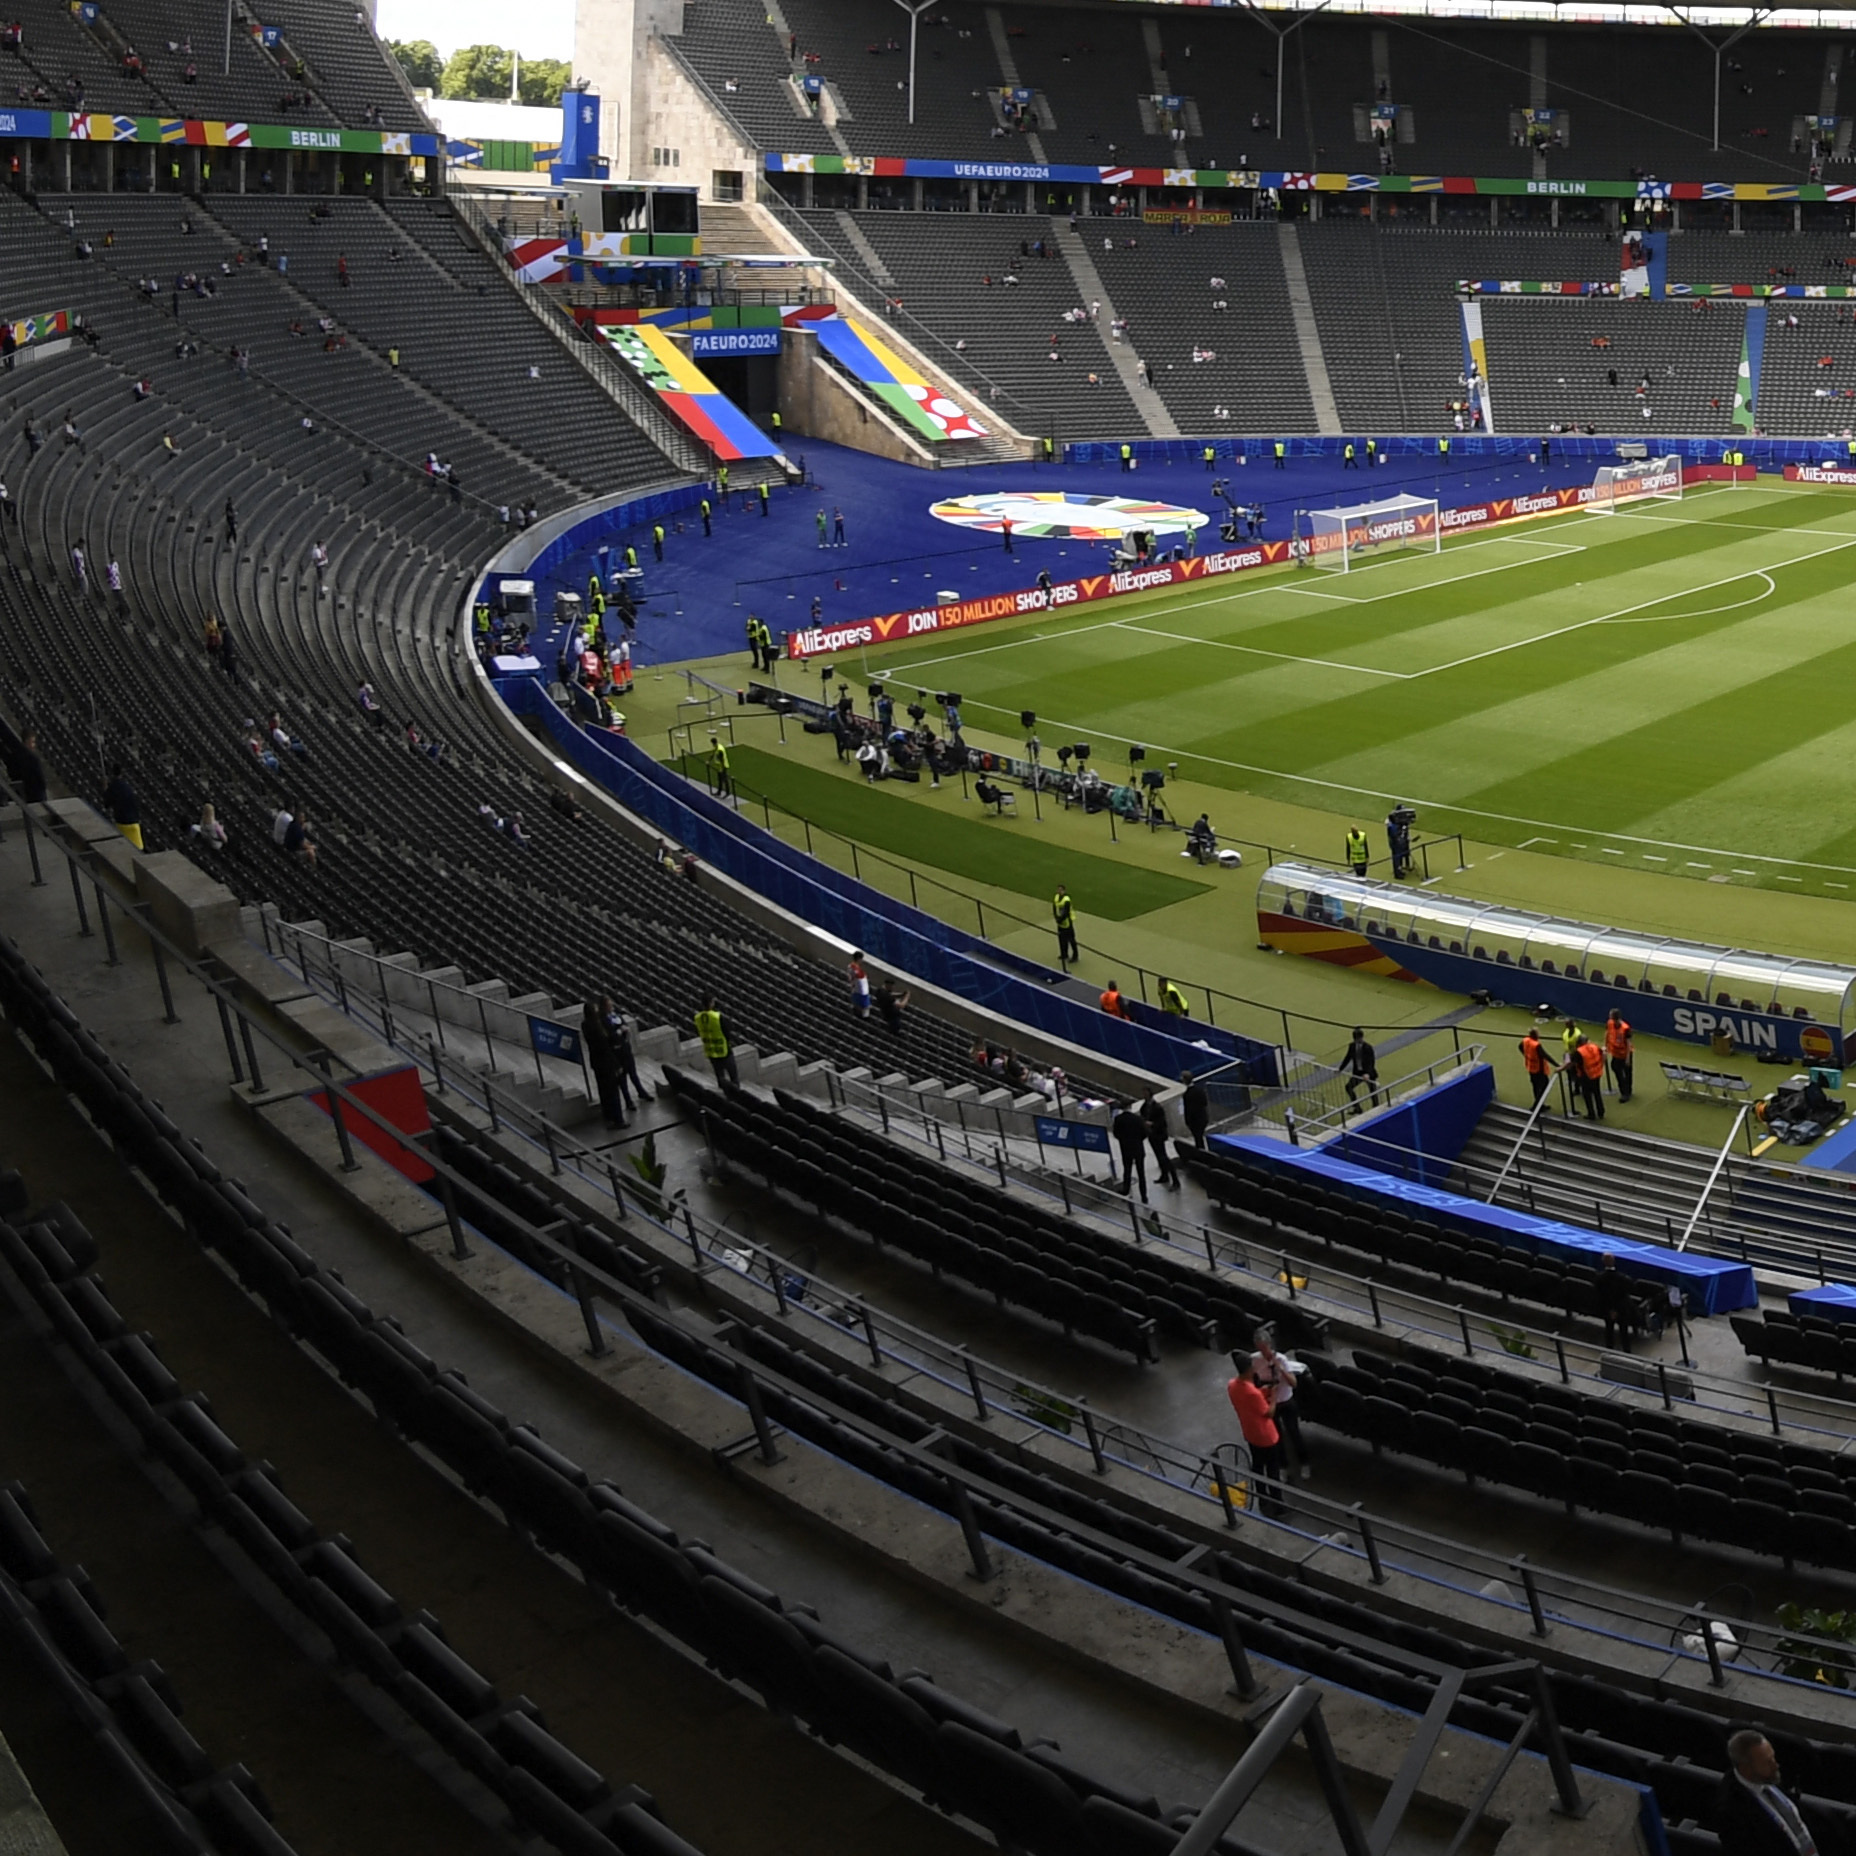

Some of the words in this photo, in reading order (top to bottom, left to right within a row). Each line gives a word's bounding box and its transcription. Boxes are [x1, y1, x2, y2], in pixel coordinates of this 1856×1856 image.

[291, 130, 342, 148] BERLIN
[954, 164, 1050, 179] UEFAEURO2024
[1527, 181, 1587, 194] BERLIN
[1577, 488, 1596, 502] JOIN
[1640, 472, 1677, 492] SHOPPERS
[1439, 509, 1488, 528] AliExpress
[1511, 496, 1558, 514] AliExpress
[1368, 518, 1416, 542] SHOPPERS
[793, 625, 873, 655] AliExpress
[907, 610, 938, 634] JOIN
[938, 606, 962, 625] 150
[962, 597, 1016, 623] MILLION
[1015, 584, 1079, 612] SHOPPERS
[1108, 567, 1173, 594] AliExpress
[1202, 551, 1262, 575] AliExpress
[1673, 1007, 1778, 1050] SPAIN
